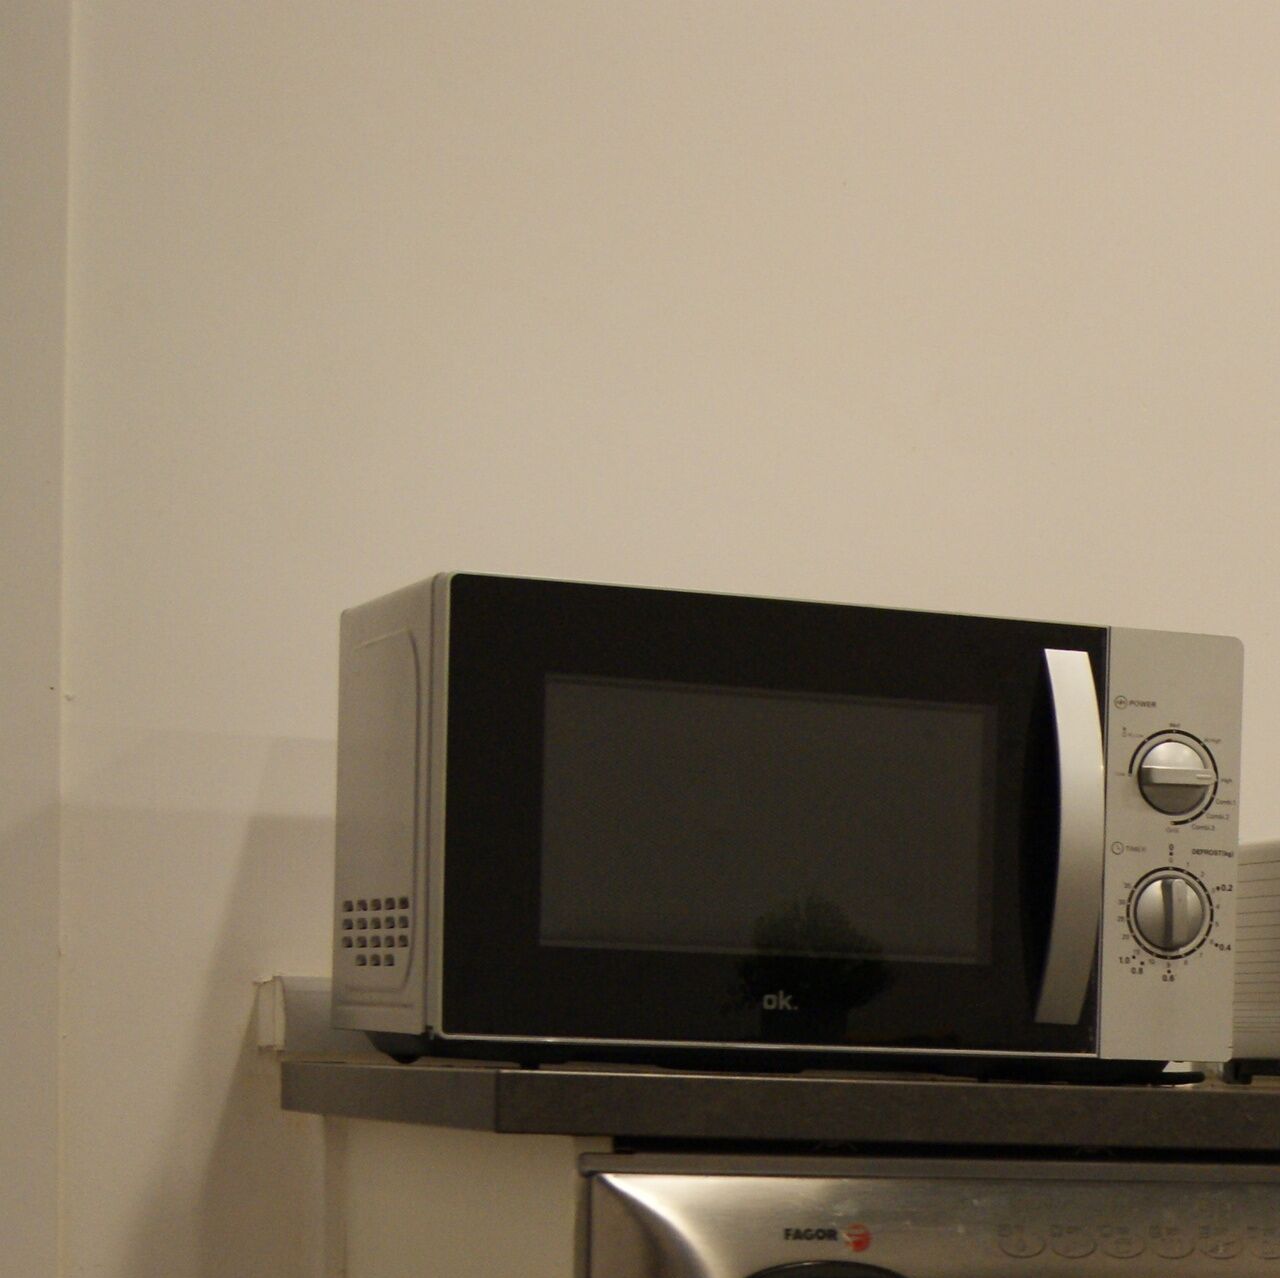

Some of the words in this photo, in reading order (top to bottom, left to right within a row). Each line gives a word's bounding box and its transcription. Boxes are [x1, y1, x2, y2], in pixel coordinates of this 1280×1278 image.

[1221, 884, 1233, 892] 0.2
[763, 990, 799, 1010] ok.
[784, 1228, 838, 1242] FAGOR
